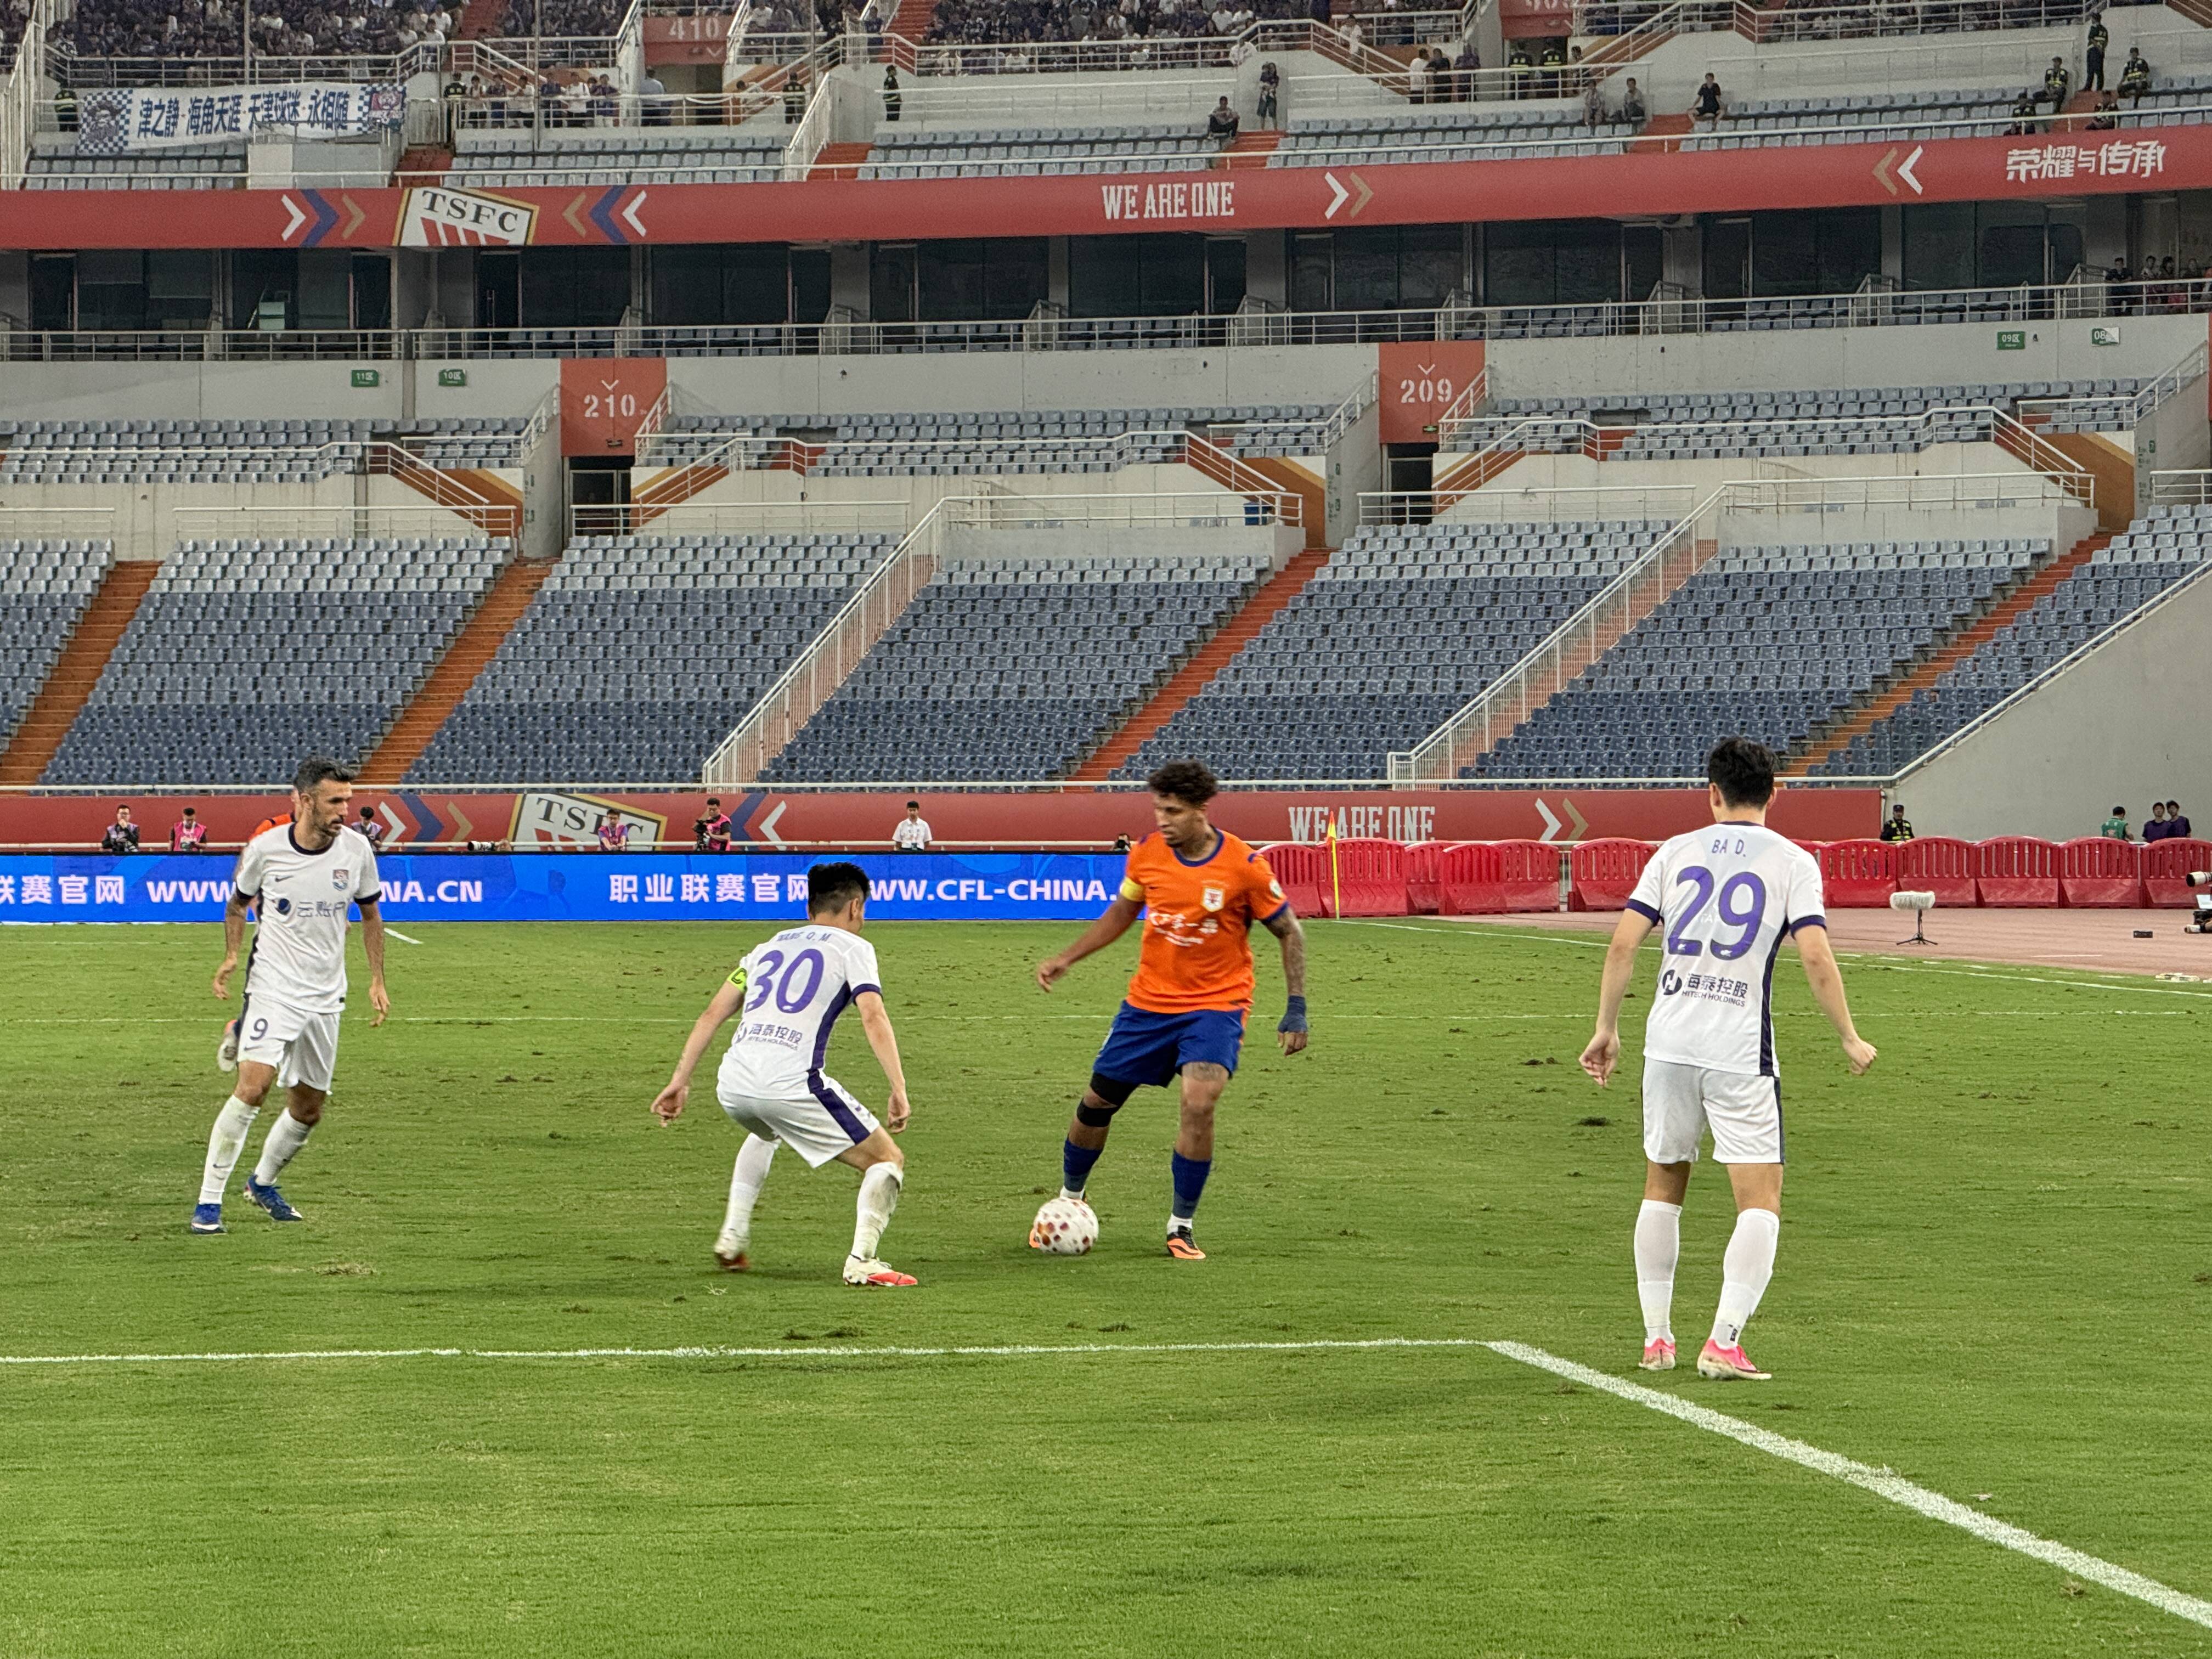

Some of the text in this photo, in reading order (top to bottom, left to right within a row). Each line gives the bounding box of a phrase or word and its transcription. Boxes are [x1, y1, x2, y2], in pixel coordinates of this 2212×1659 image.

[668, 17, 720, 40] 410
[2006, 140, 2166, 184] 荣耀与传承
[422, 190, 518, 233] TSFC
[1102, 182, 1234, 219] WE ARE ONE
[1400, 378, 1452, 403] 209
[584, 394, 635, 417] 210
[1712, 839, 1746, 857] BA D.
[1668, 866, 1767, 961] 29
[744, 949, 825, 1014] 30
[1686, 973, 1748, 999] 海泰控股
[1681, 990, 1746, 1007] HITECH HOLDINGS
[250, 1018, 269, 1041] 9
